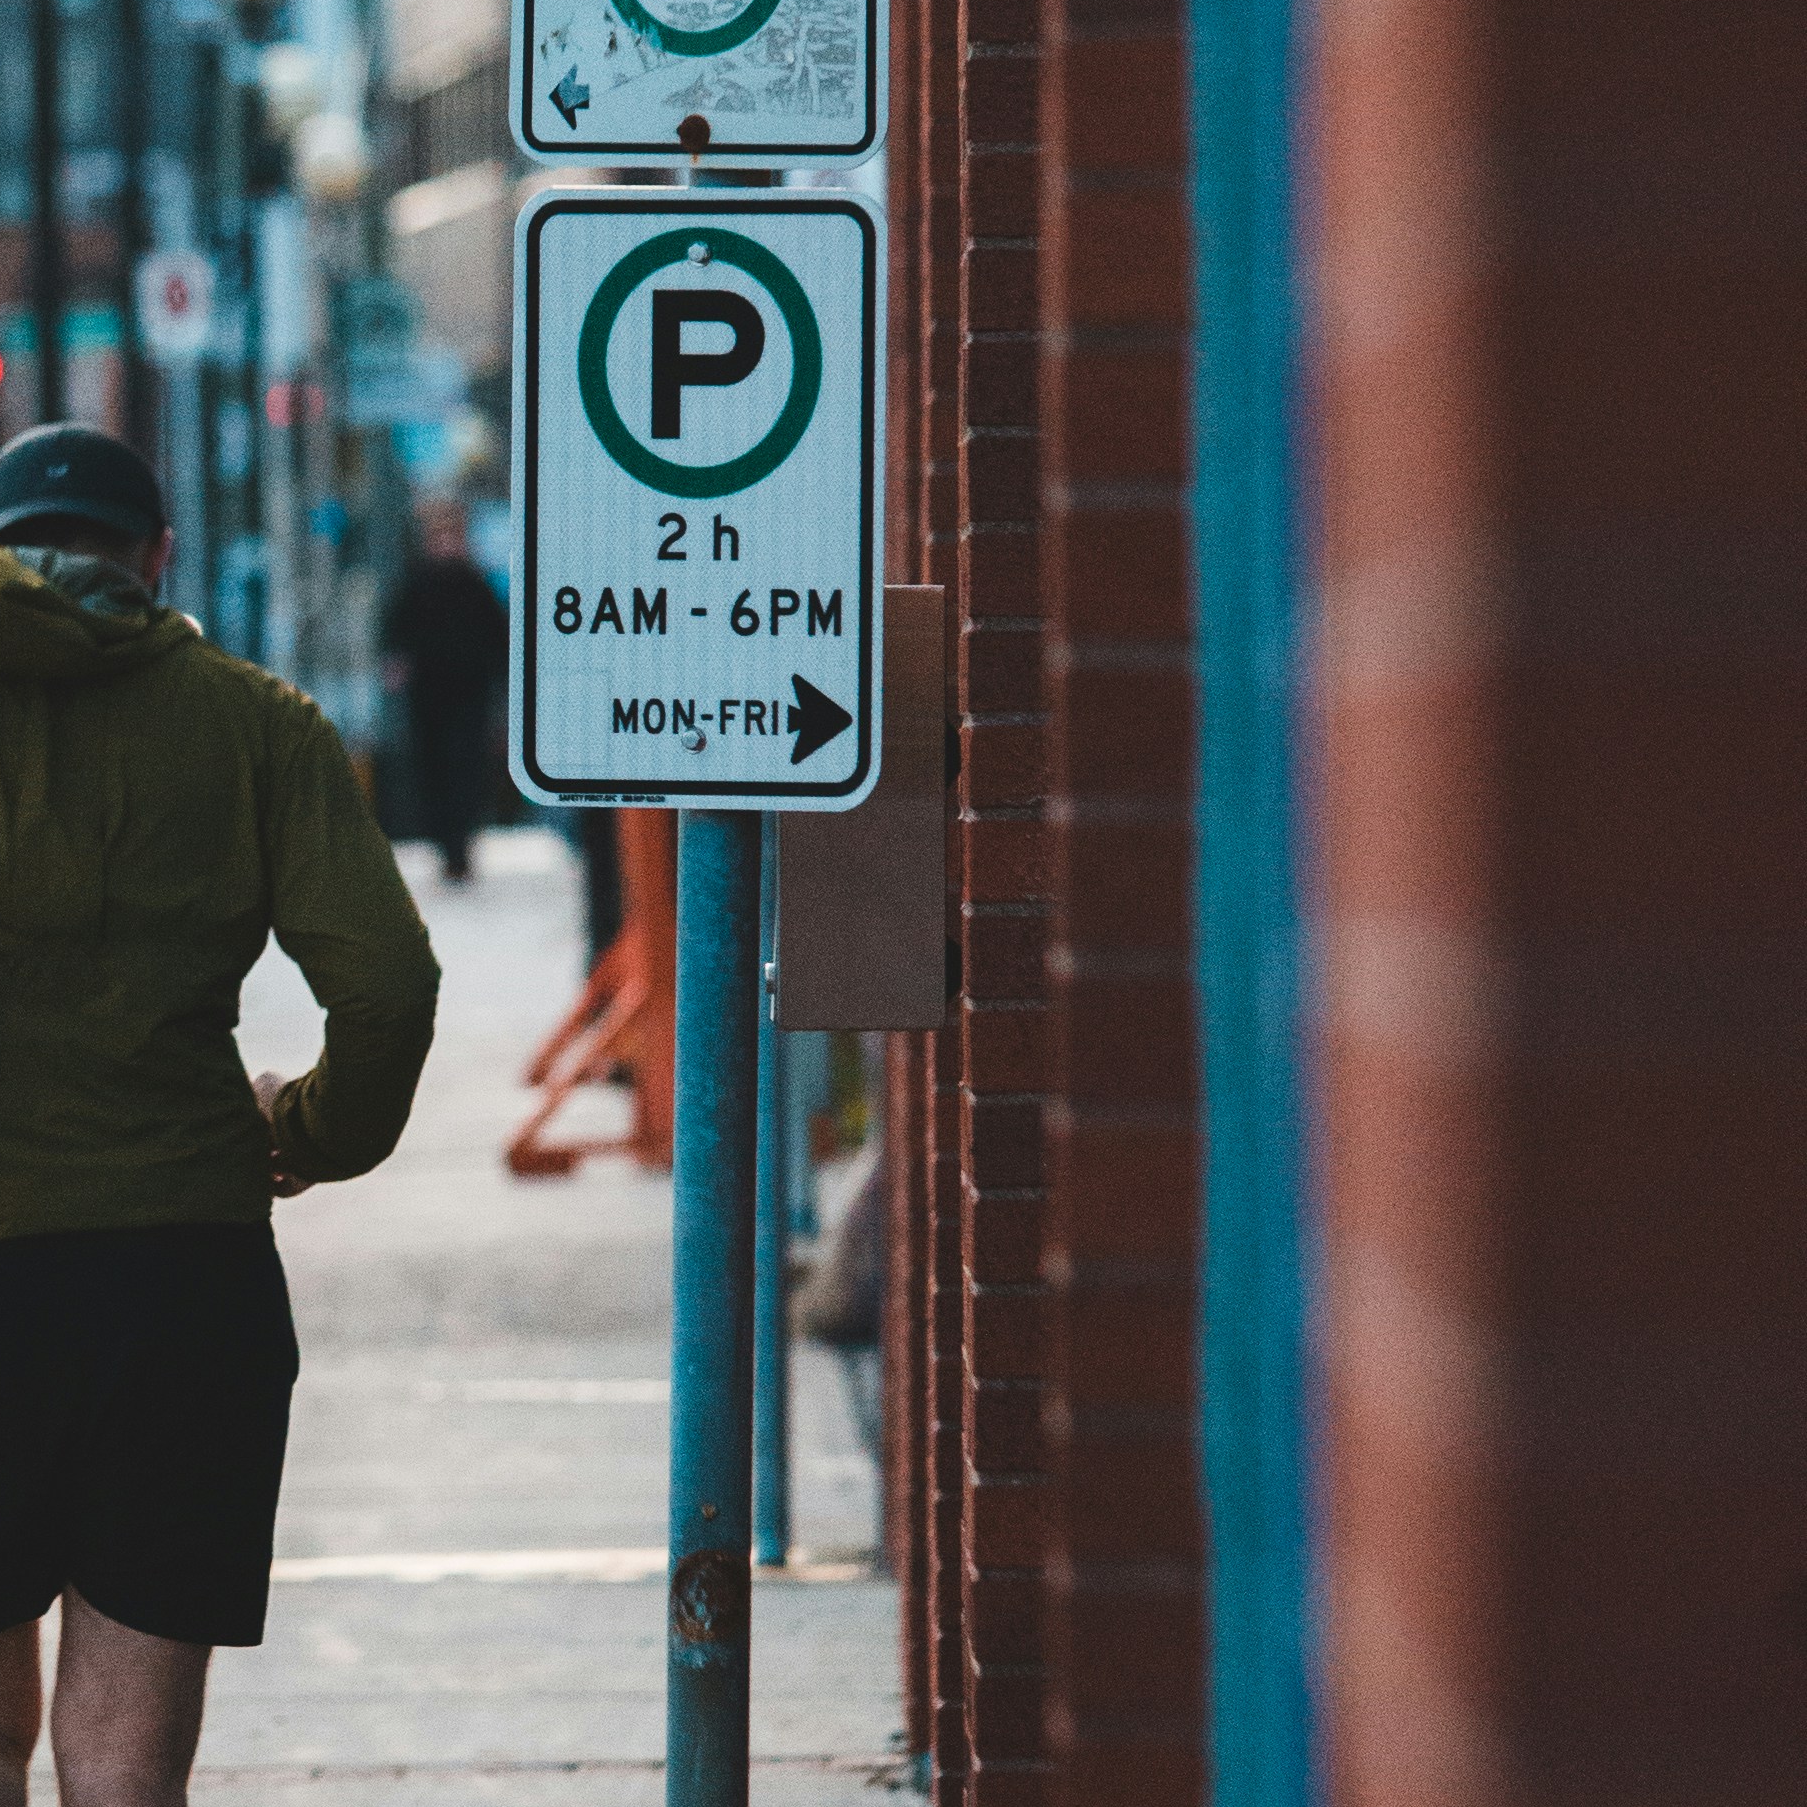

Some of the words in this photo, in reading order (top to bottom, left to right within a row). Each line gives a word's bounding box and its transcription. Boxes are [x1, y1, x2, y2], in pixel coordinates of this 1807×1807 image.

[651, 289, 765, 440] P
[657, 512, 687, 561] 2
[713, 513, 740, 561] h
[553, 585, 667, 635] 8AM
[690, 607, 708, 617] -
[730, 588, 842, 637] 6PM
[612, 698, 779, 736] MON-FRI
